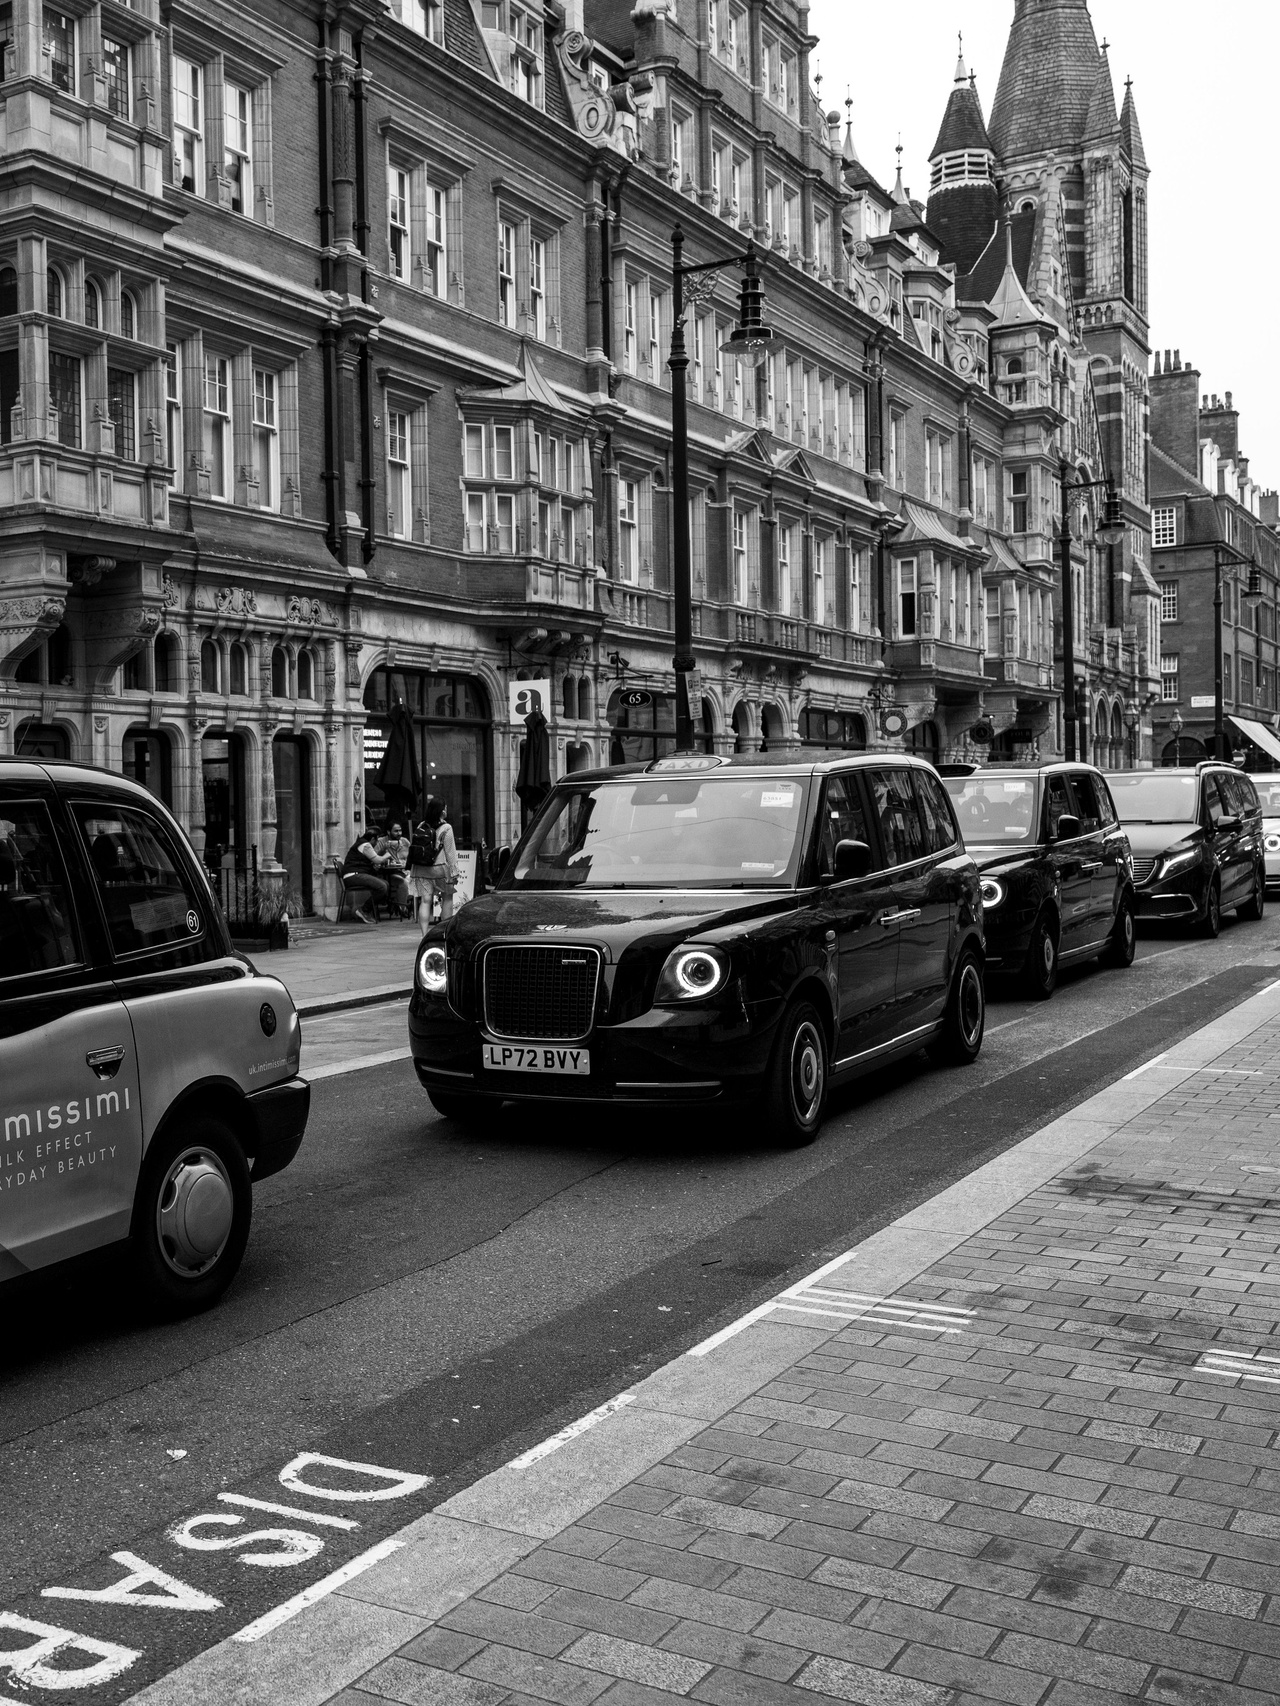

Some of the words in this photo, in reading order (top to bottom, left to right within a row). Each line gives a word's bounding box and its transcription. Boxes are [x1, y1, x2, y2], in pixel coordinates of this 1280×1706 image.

[629, 692, 642, 704] 65
[653, 759, 704, 771] TAXI
[188, 914, 198, 928] 61
[248, 1055, 297, 1075] uk.intimissimi.com
[489, 1046, 538, 1068] LP72
[543, 1049, 581, 1070] BVY
[36, 1130, 92, 1158] EFFECT
[58, 1144, 117, 1174] BEAUTY
